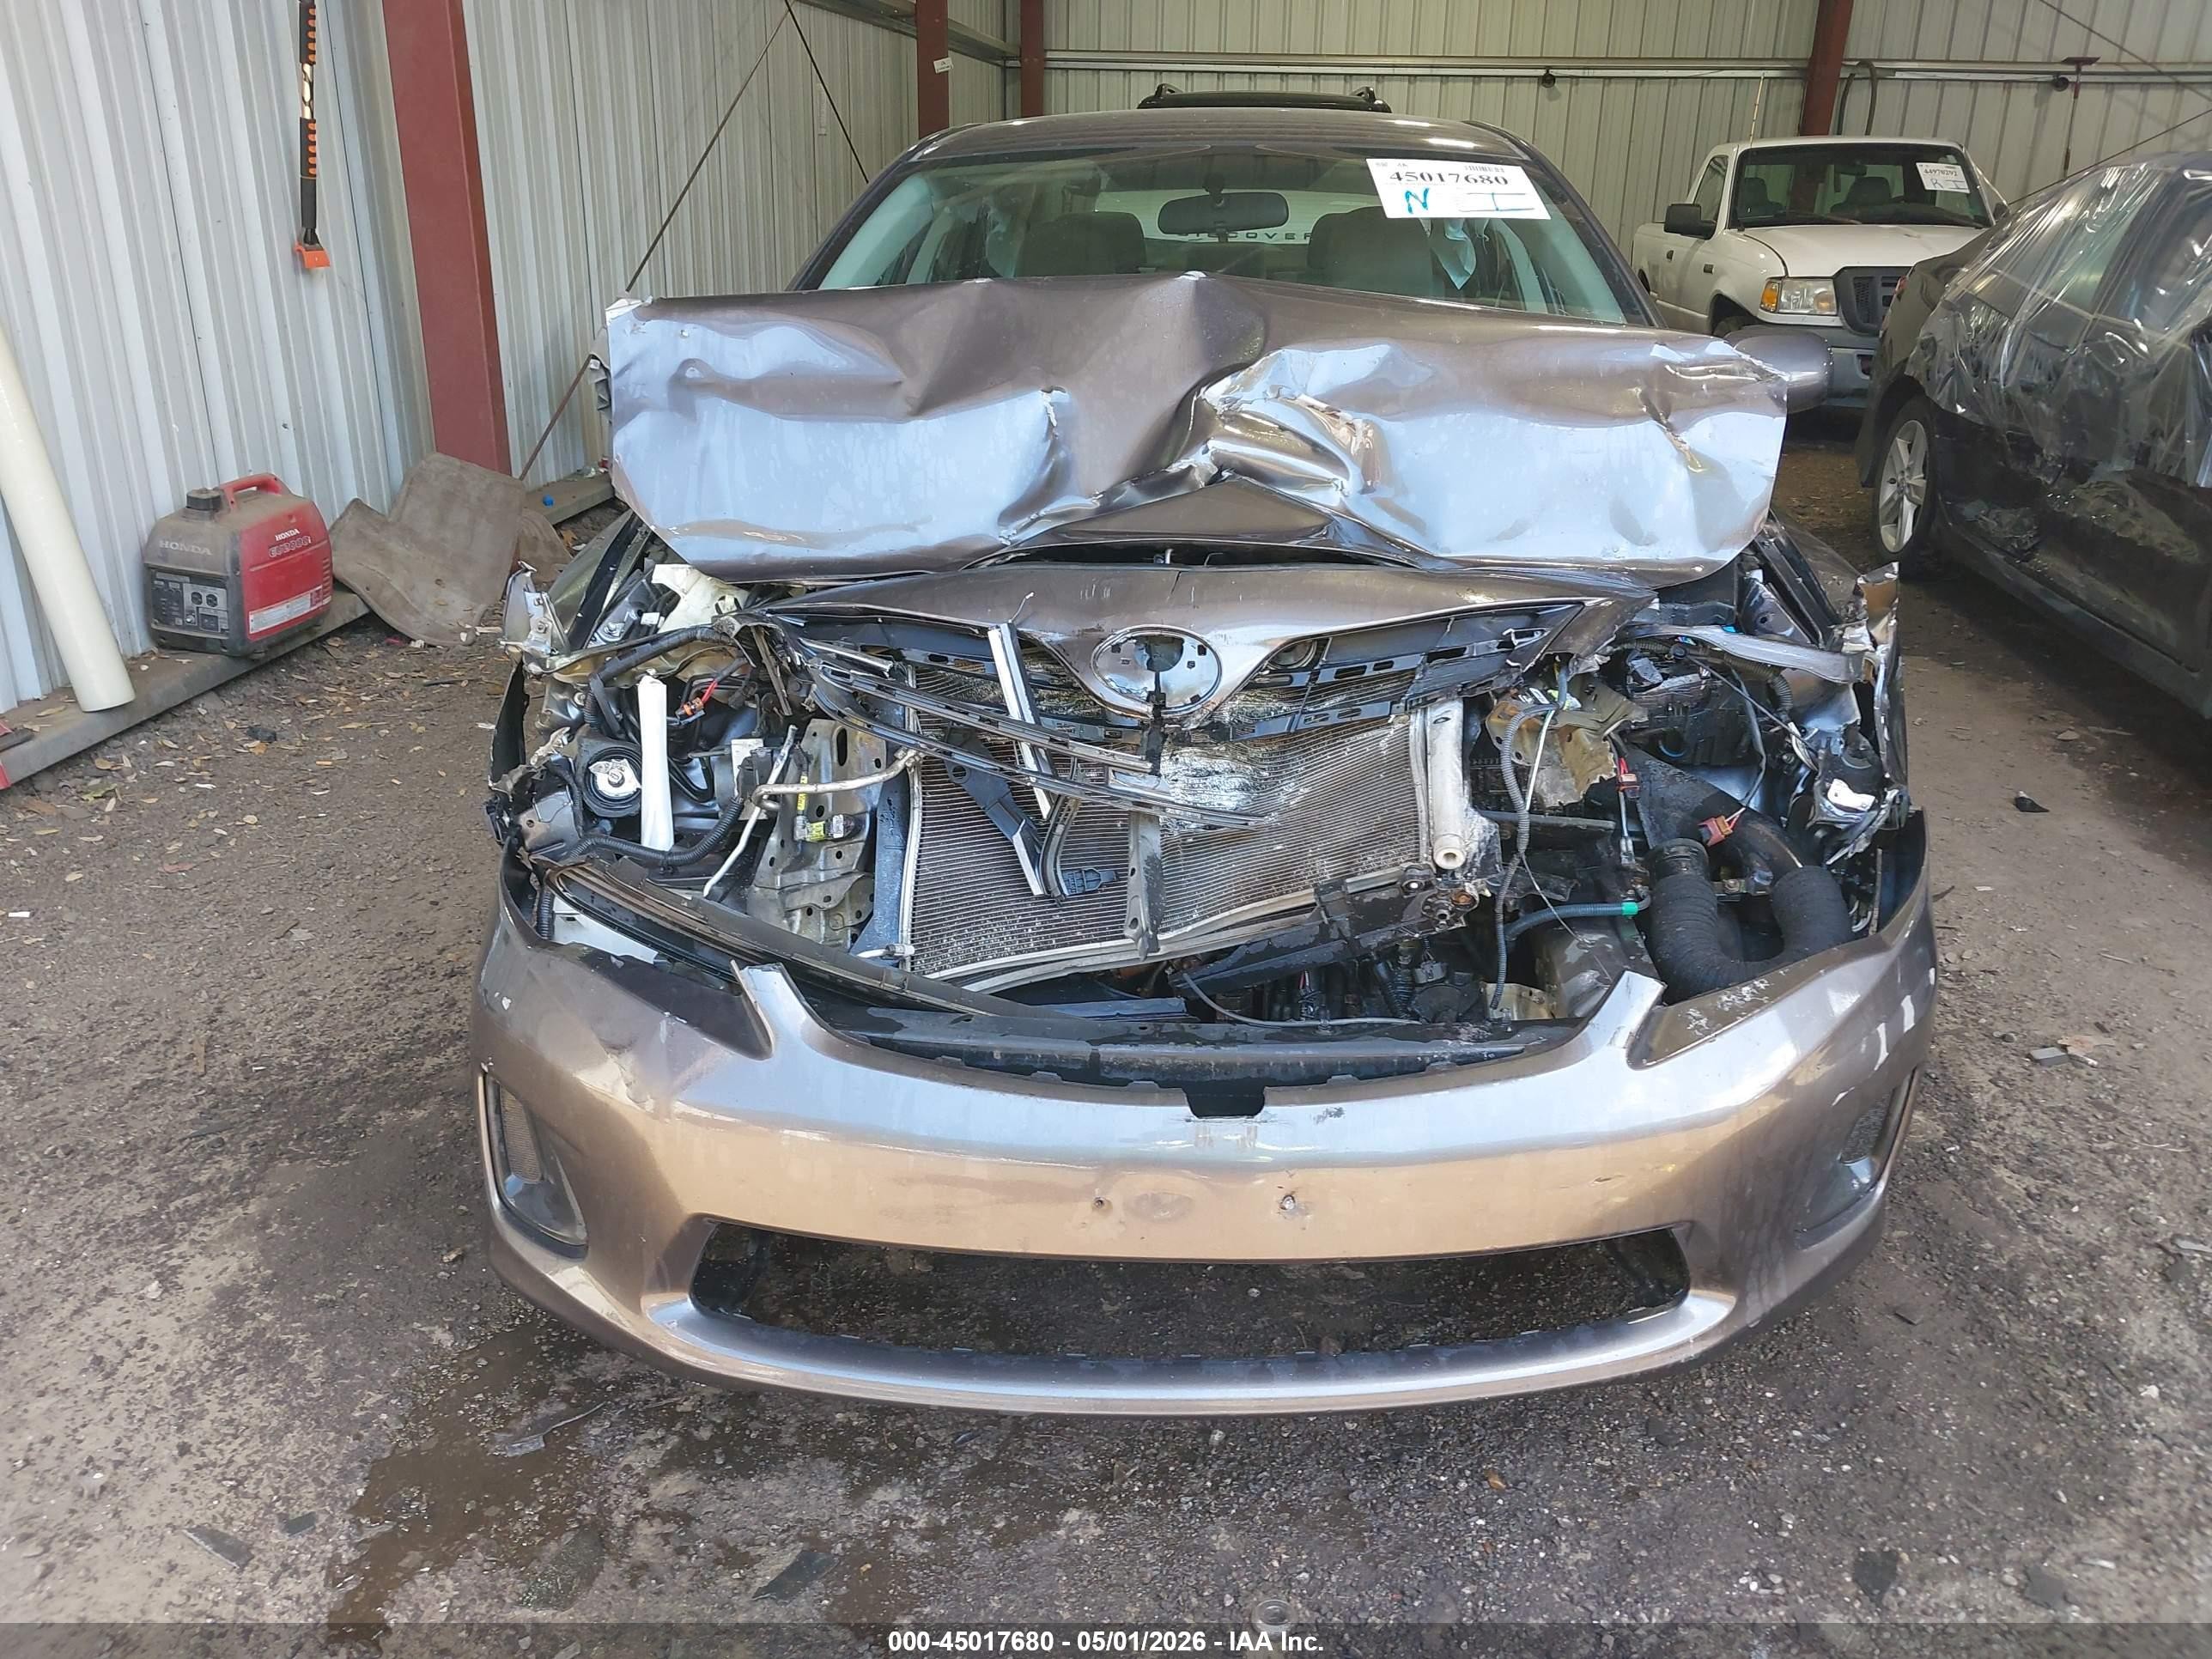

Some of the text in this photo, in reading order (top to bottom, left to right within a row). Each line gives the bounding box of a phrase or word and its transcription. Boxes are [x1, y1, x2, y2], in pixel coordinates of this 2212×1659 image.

[1389, 171, 1509, 185] 45017680
[1405, 187, 1430, 214] N
[274, 527, 301, 542] HONDA
[158, 539, 213, 556] HONDA
